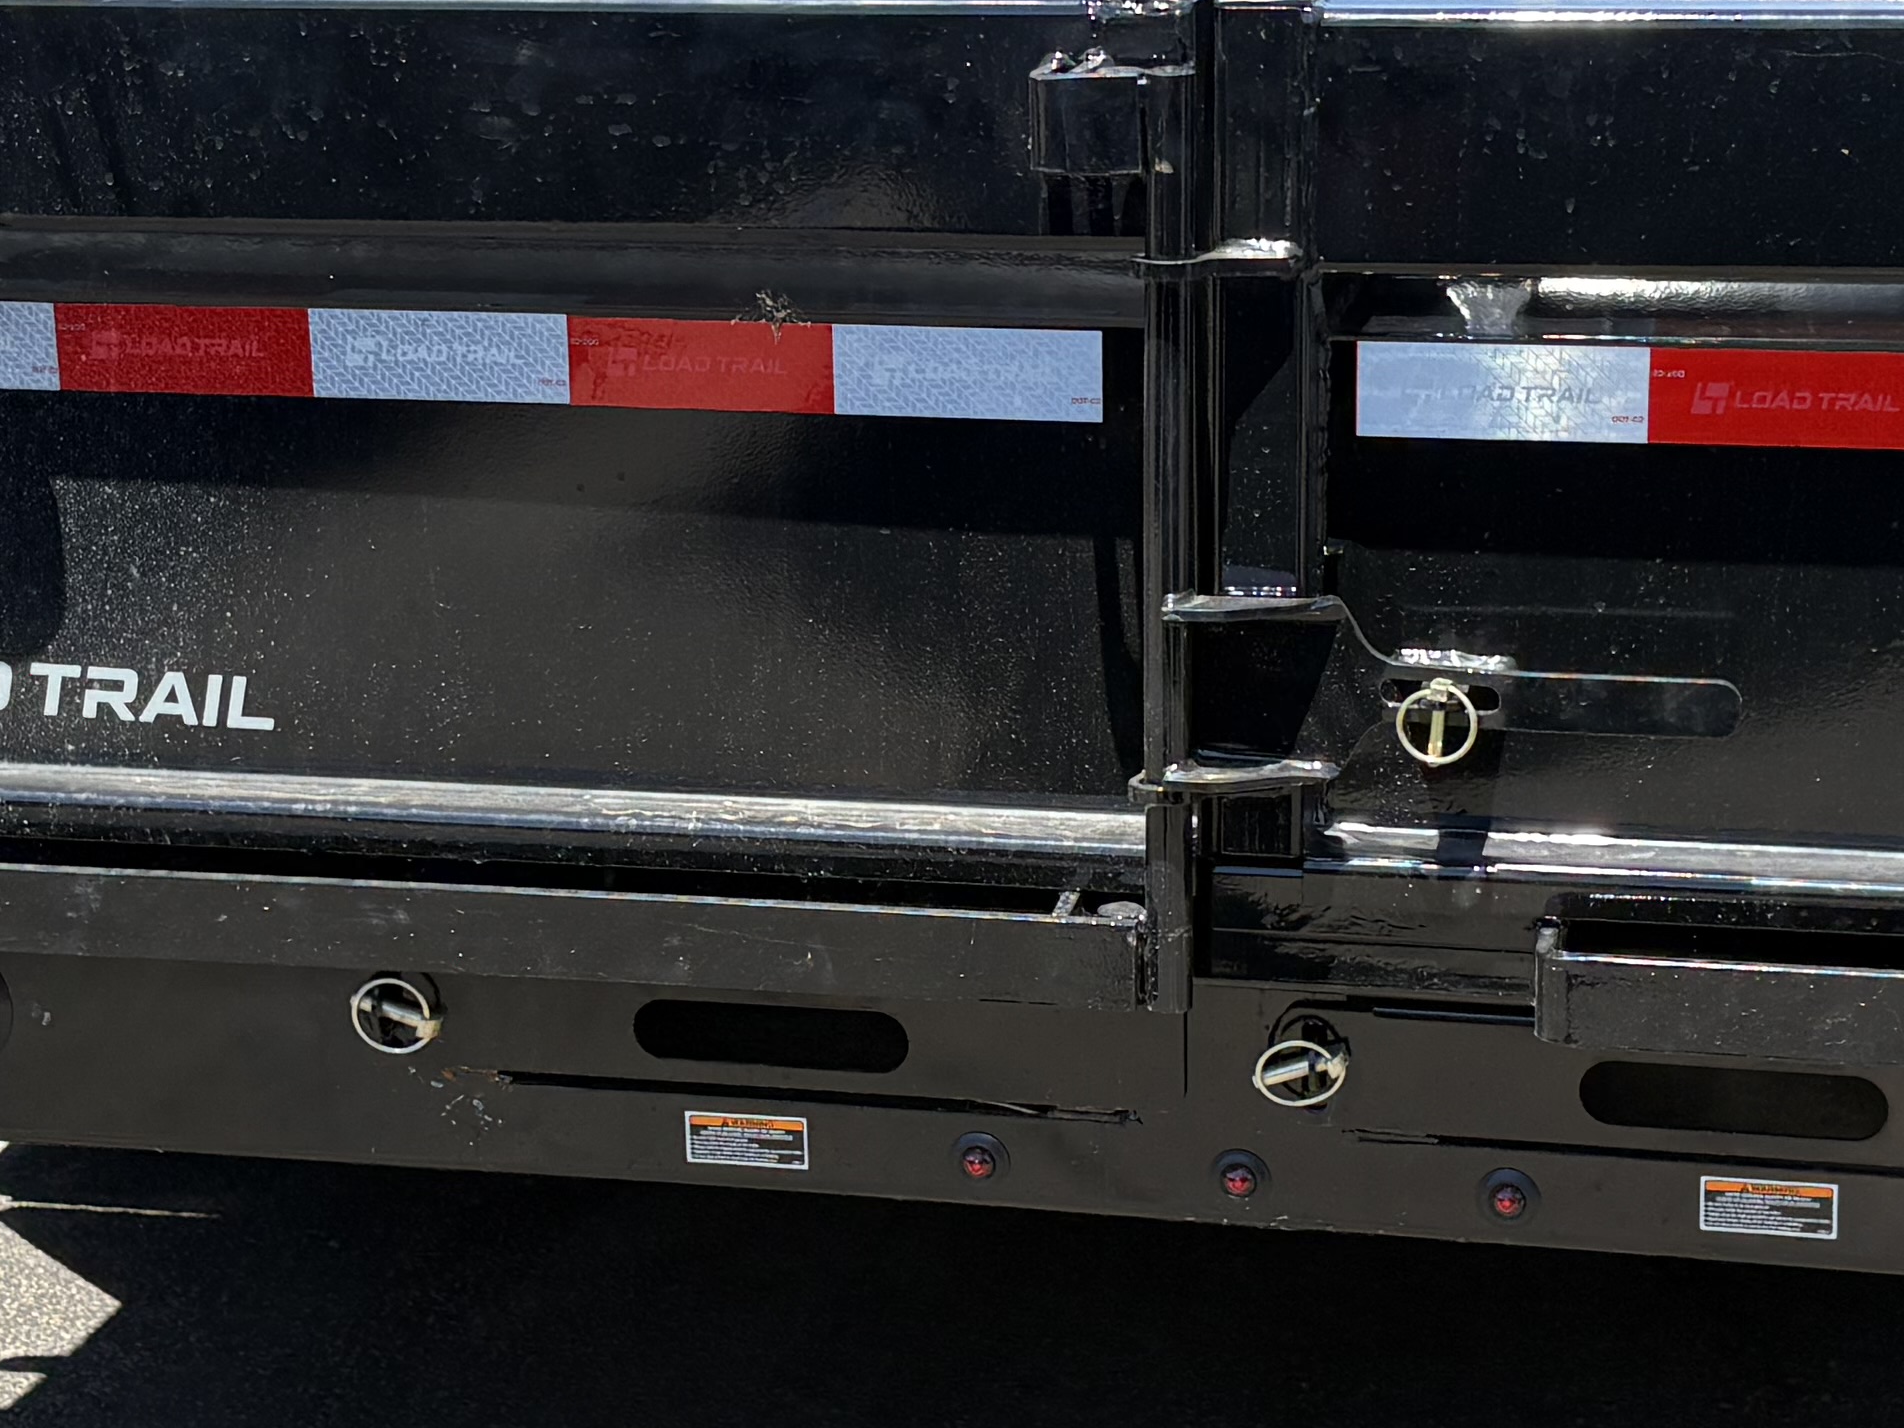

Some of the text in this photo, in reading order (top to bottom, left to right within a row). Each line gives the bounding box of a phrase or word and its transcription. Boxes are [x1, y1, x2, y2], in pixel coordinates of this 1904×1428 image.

[642, 355, 787, 374] LOAD TRAIL
[1519, 385, 1602, 404] TRAIL
[1734, 391, 1901, 412] LOAD TRAIL
[30, 662, 275, 731] TRAIL
